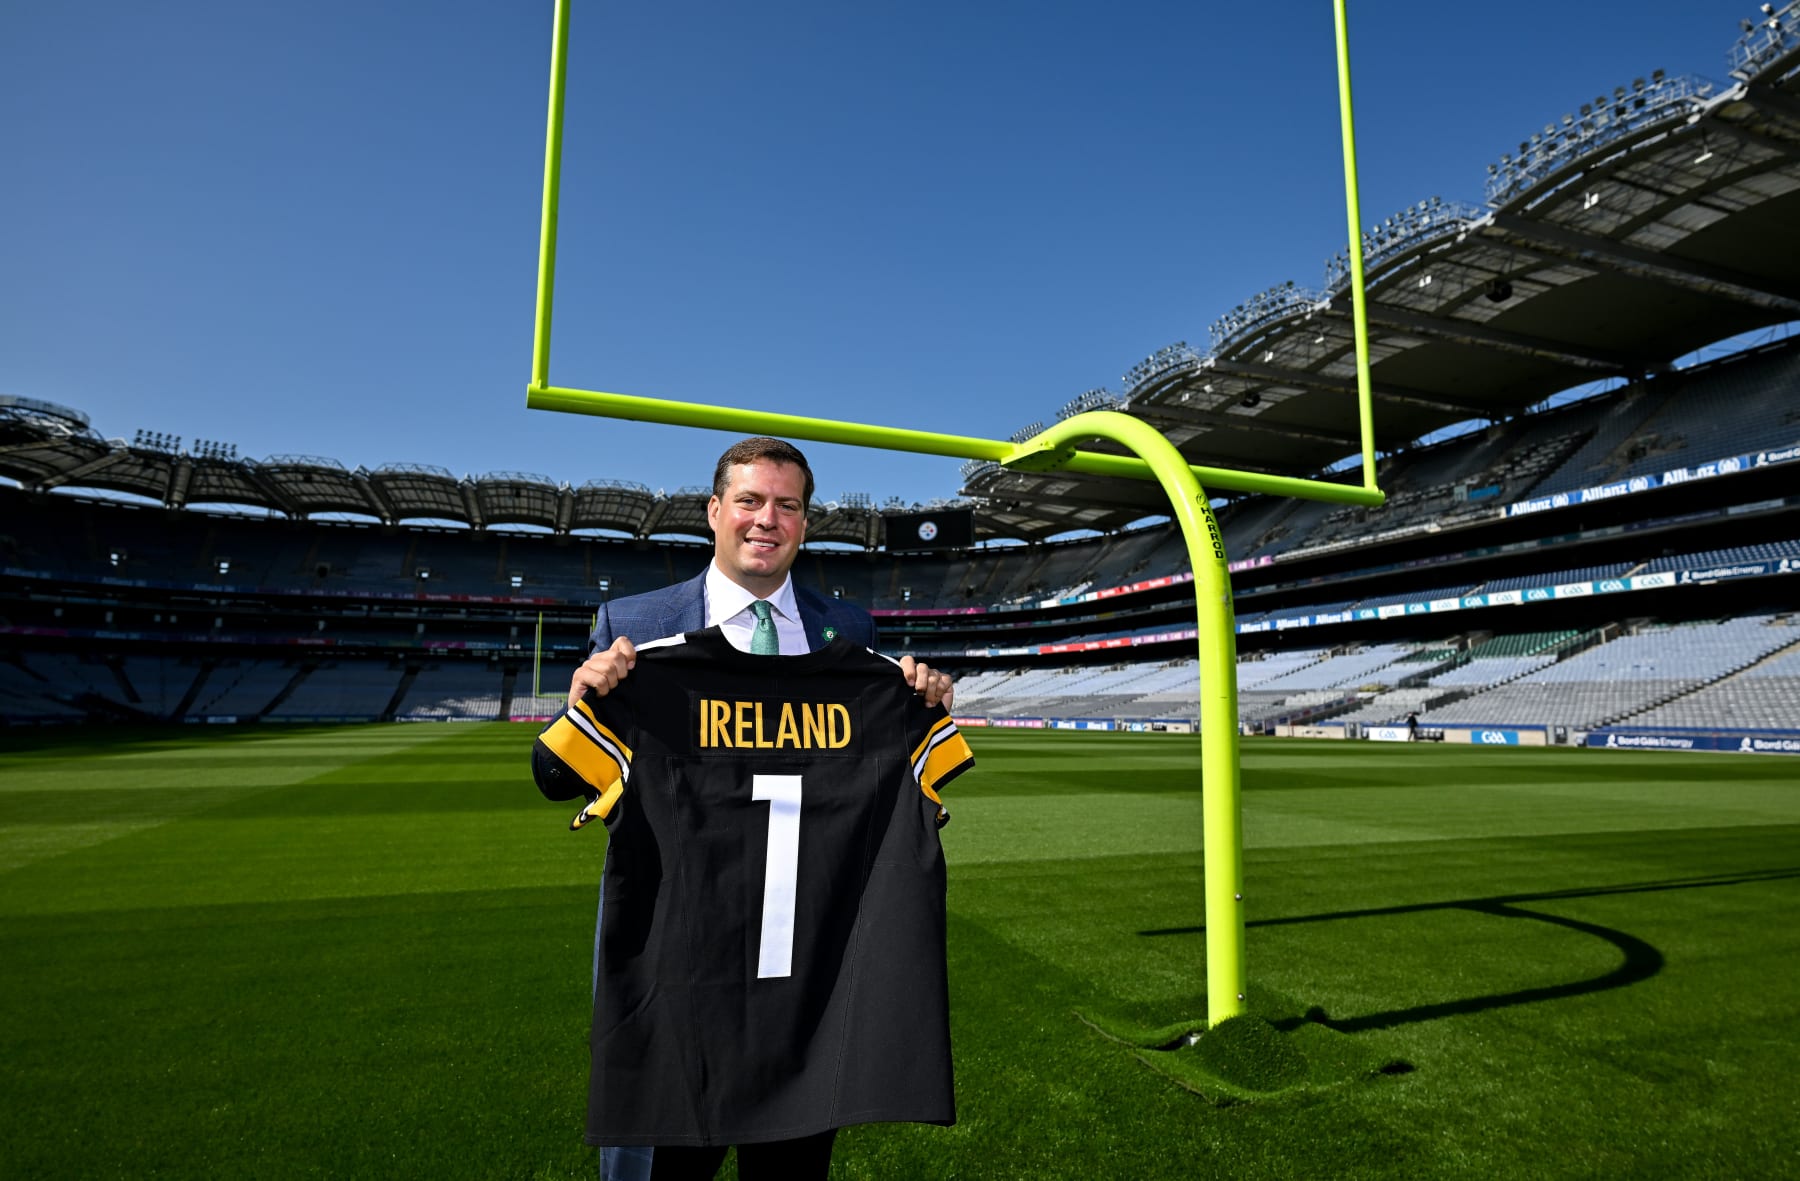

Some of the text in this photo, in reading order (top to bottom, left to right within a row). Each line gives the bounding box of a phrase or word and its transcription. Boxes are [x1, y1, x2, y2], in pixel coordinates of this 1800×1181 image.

[1582, 484, 1627, 502] Allianz
[1510, 499, 1552, 516] Allianz
[1200, 507, 1224, 559] HARROD
[1600, 580, 1625, 592] GAA
[1464, 596, 1484, 607] GAA
[1527, 589, 1549, 600] GAA
[1409, 603, 1426, 613] GAA
[699, 699, 851, 749] IRELAND
[1481, 730, 1506, 744] GAA
[751, 774, 803, 979] 1
